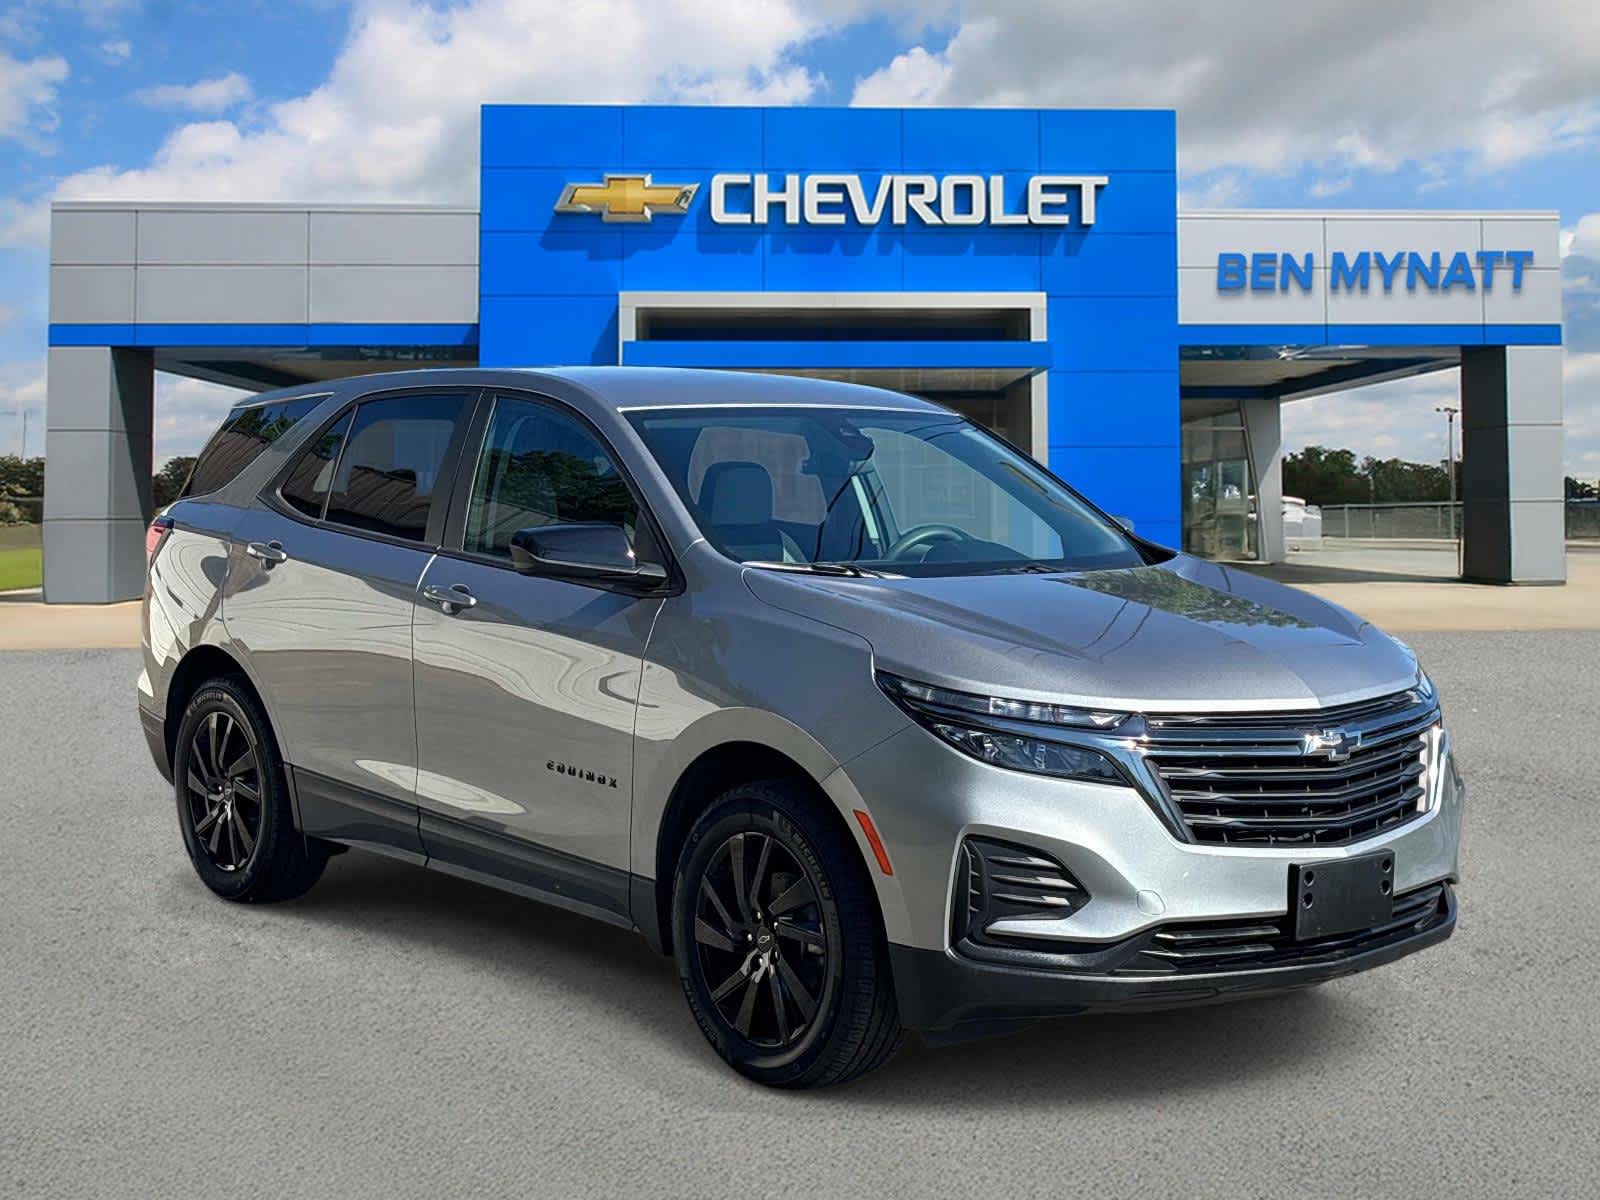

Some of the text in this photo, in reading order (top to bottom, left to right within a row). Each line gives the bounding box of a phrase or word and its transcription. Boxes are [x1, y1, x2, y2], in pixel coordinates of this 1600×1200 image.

[710, 173, 1109, 226] CHEVROLET
[1217, 251, 1534, 290] BEN MYNATT
[546, 760, 617, 788] EQUINOX
